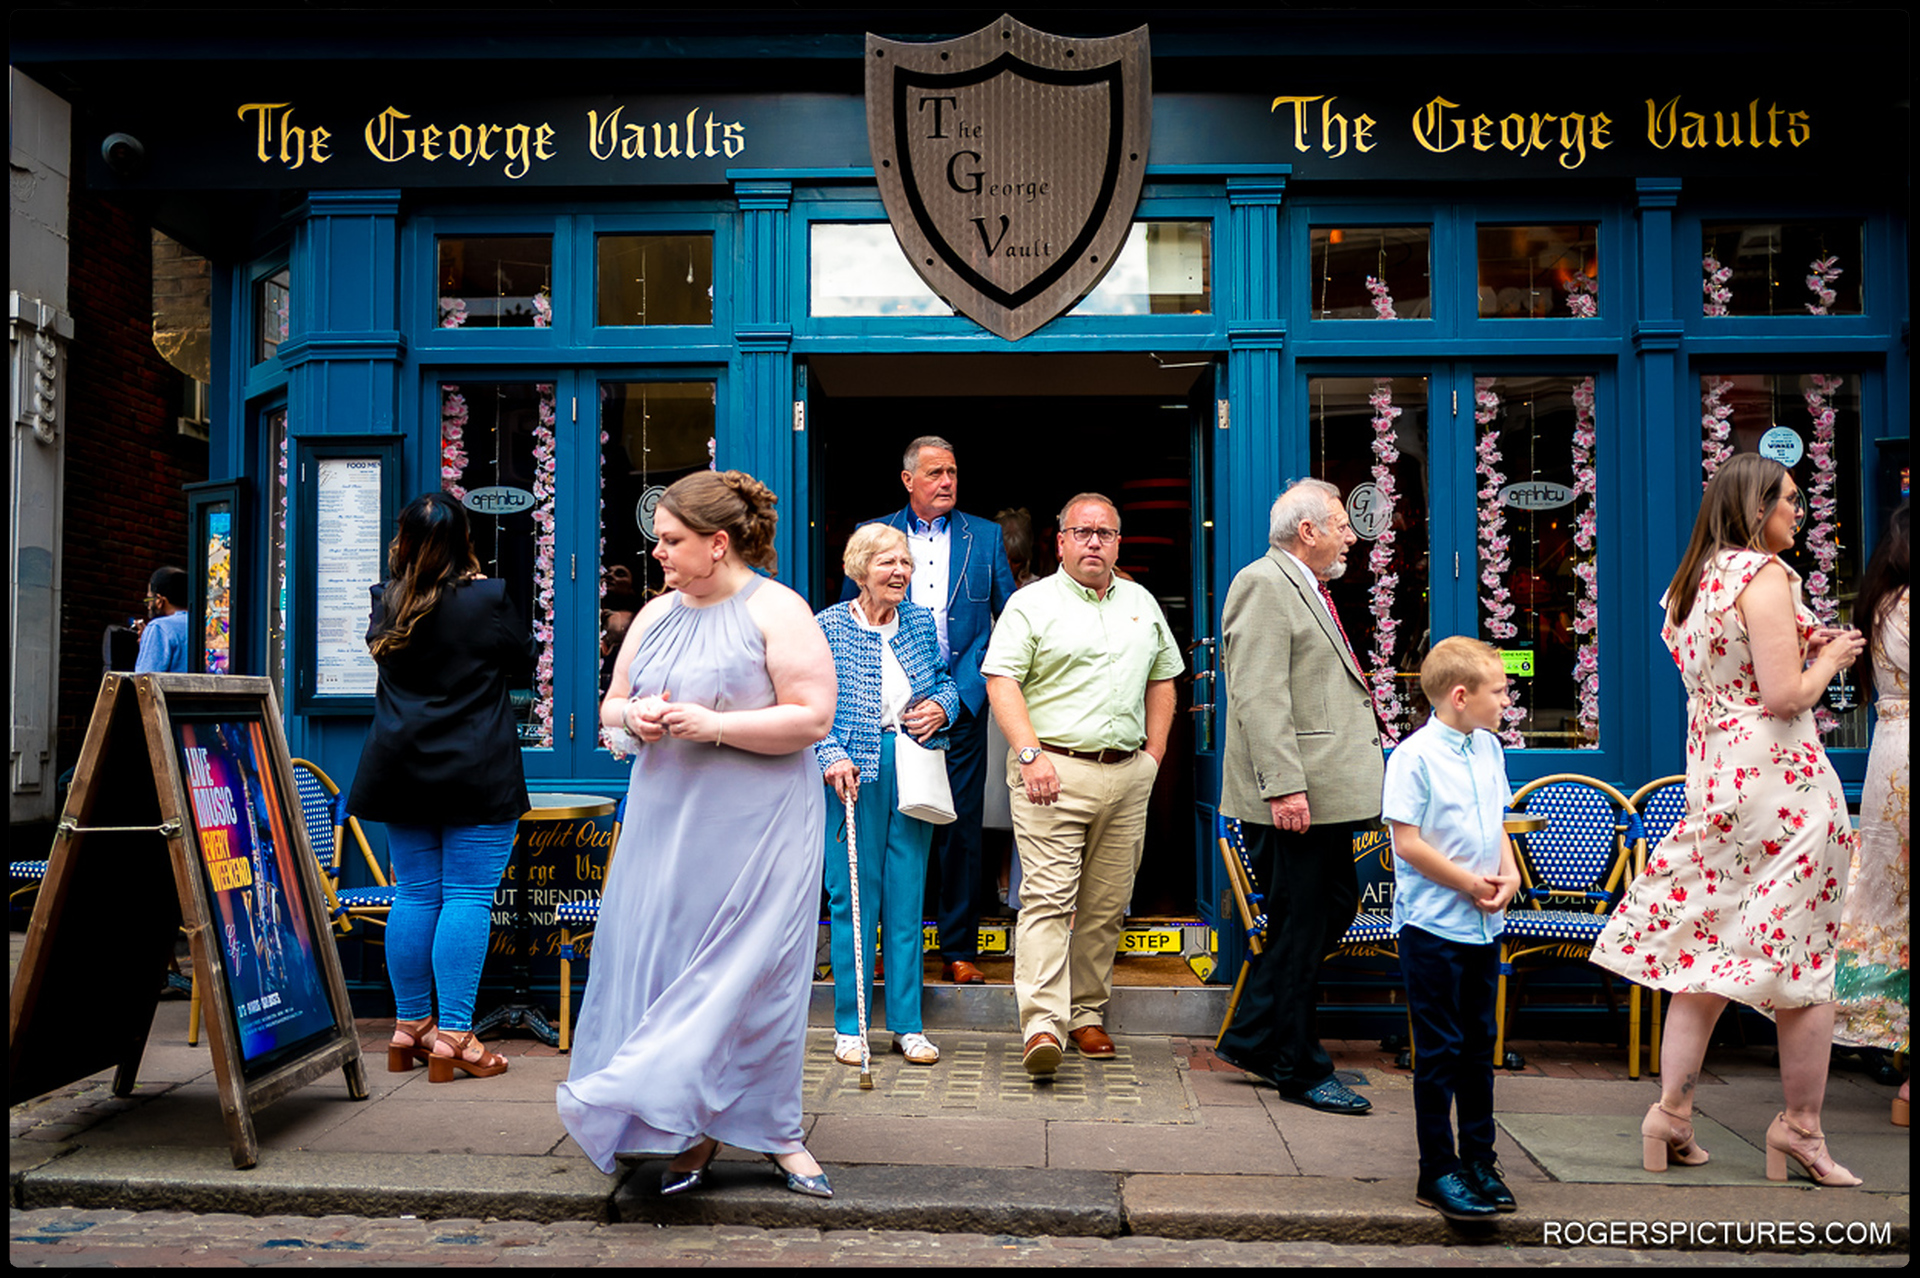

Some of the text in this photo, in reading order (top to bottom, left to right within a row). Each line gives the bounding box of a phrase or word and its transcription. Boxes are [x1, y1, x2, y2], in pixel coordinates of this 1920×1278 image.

[918, 96, 983, 139] The
[1270, 94, 1811, 169] The George Vaults
[238, 102, 746, 179] The George Vaults
[946, 150, 1050, 203] George
[969, 214, 1052, 259] Vault
[184, 747, 214, 787] LIVE
[192, 786, 238, 829] MUSIC
[201, 829, 232, 862] EVERY
[207, 856, 253, 893] WEEKEND
[1125, 935, 1170, 949] STEP
